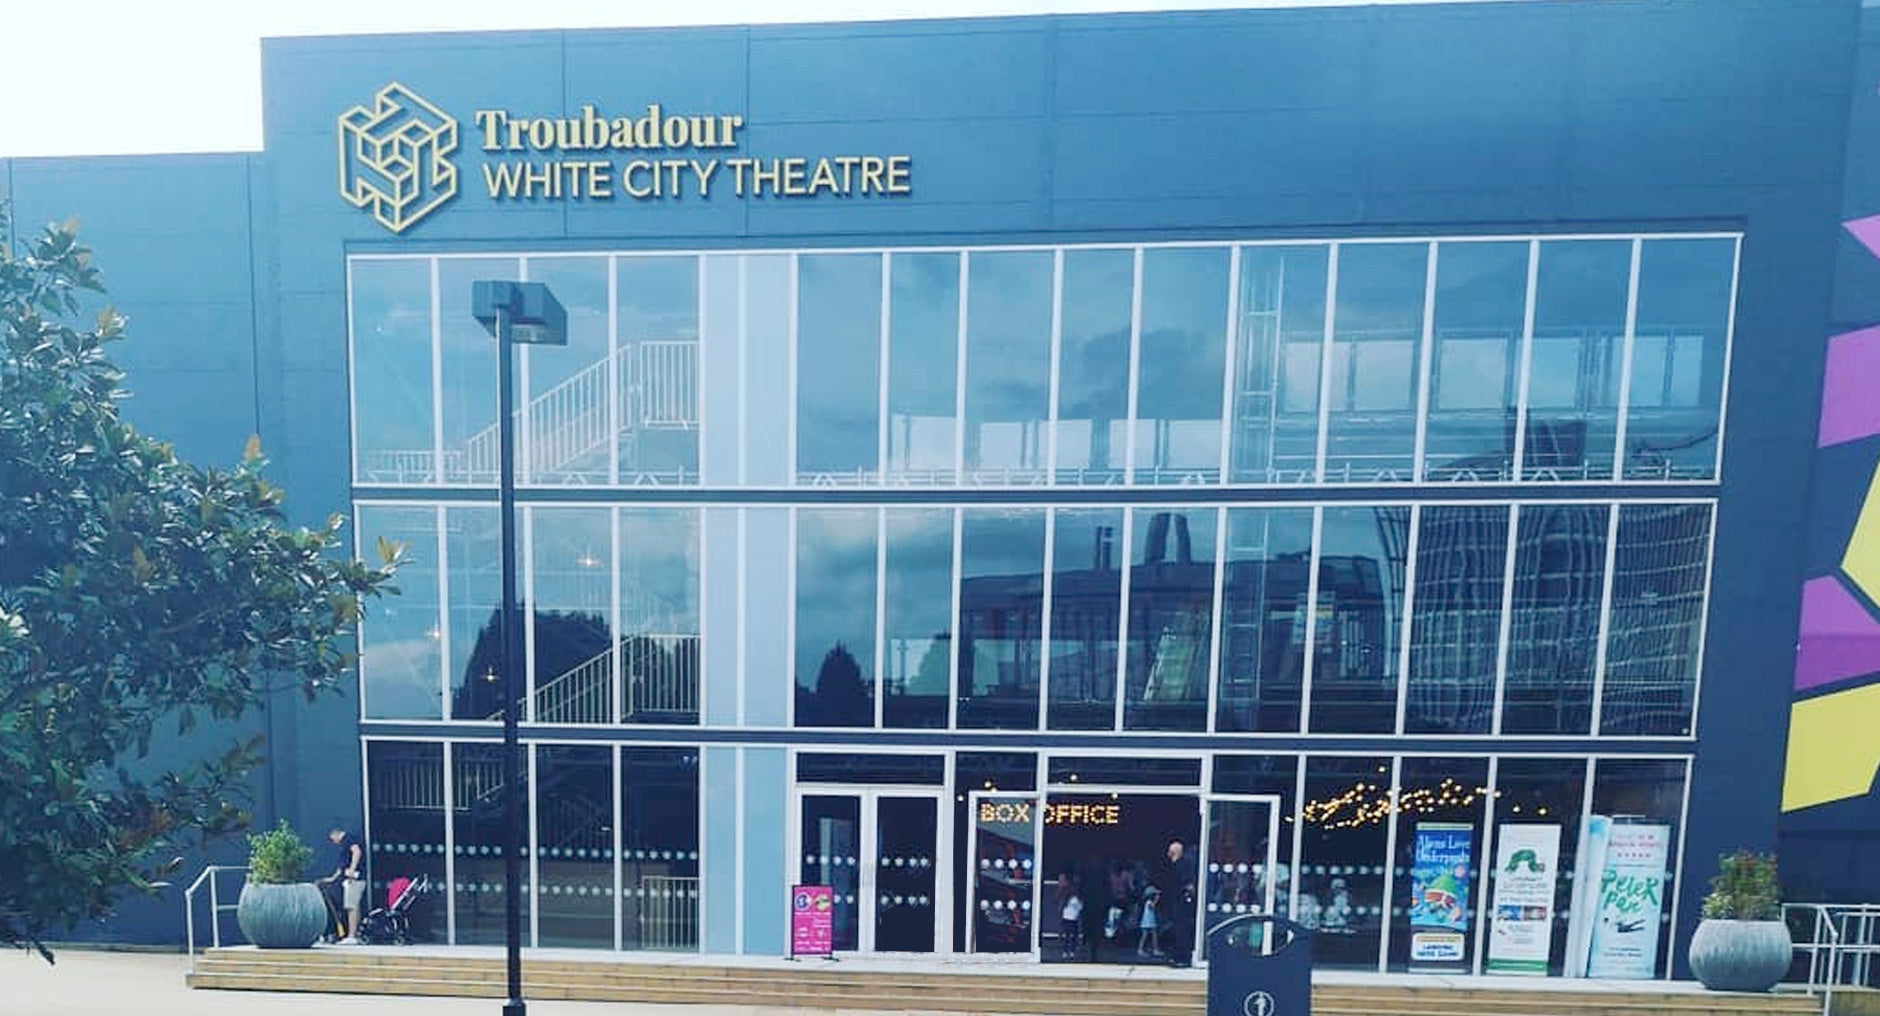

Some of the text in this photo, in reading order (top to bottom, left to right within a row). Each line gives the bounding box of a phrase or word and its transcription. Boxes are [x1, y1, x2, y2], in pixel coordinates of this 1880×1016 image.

[475, 103, 744, 151] Troubadour
[482, 156, 912, 199] WHITE CITY THEATRE
[980, 803, 1030, 823] BOX
